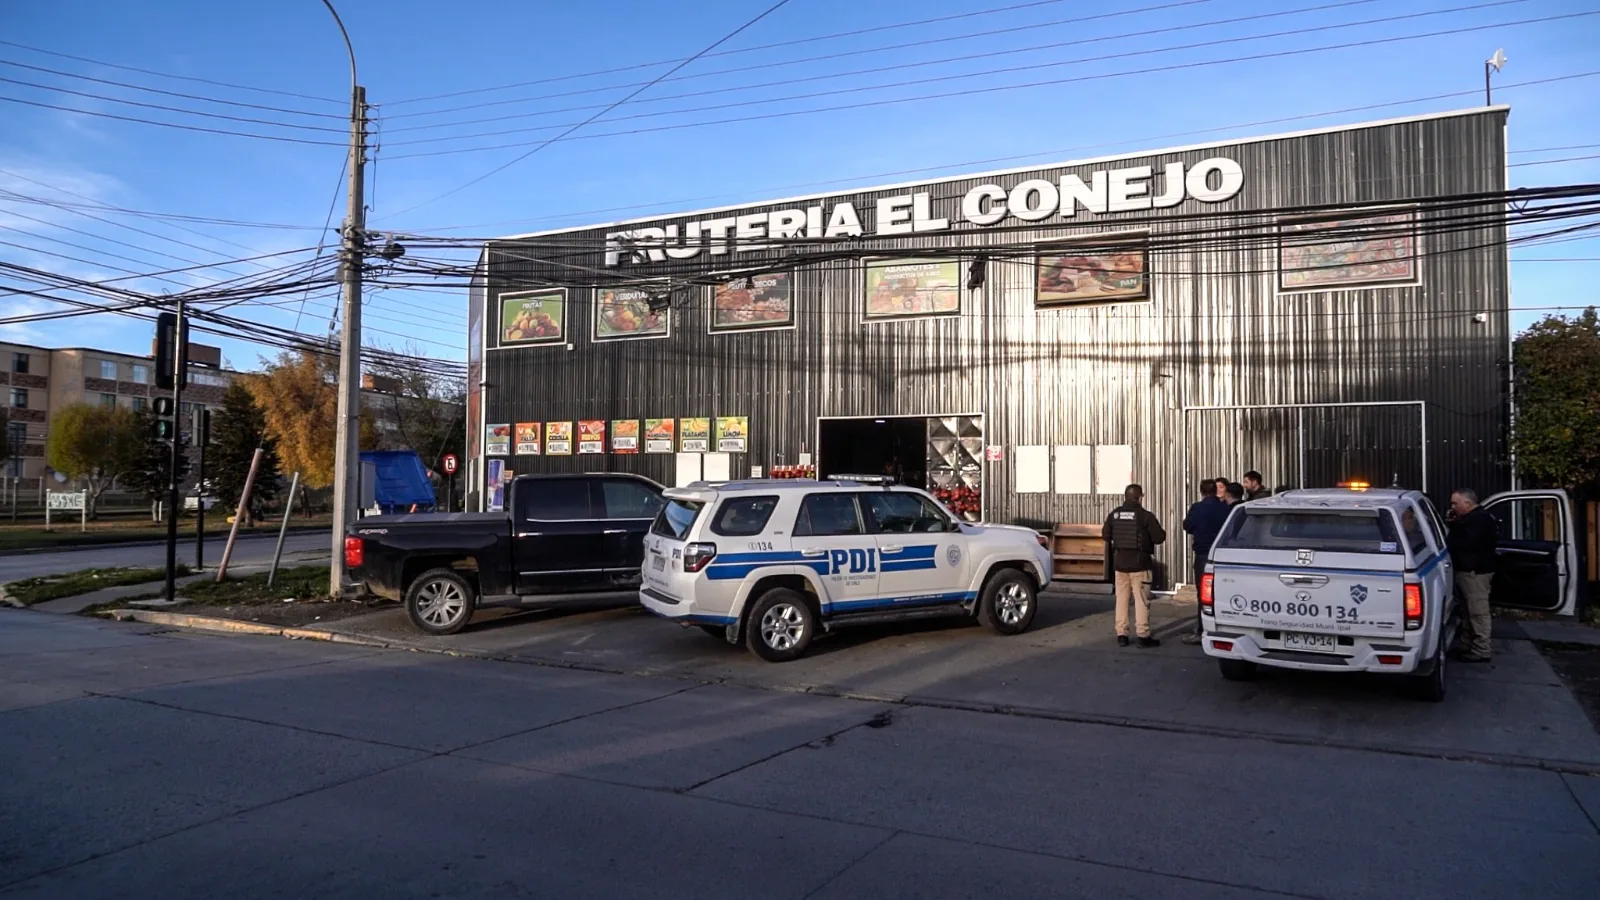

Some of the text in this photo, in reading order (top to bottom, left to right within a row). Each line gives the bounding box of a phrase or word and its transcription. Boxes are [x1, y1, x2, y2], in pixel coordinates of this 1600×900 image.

[876, 191, 949, 236] EL
[962, 157, 1244, 225] CONEJO
[754, 279, 777, 288] SECOS
[1119, 278, 1137, 288] PAN
[614, 291, 649, 301] VERDURA
[522, 301, 543, 310] FRUTAS
[757, 541, 773, 551] 134
[830, 548, 876, 575] PDI
[1250, 599, 1281, 614] 800
[1286, 602, 1319, 617] 800
[1325, 605, 1359, 621] 134
[1260, 618, 1278, 626] Fono
[1279, 619, 1314, 629] Seguridad
